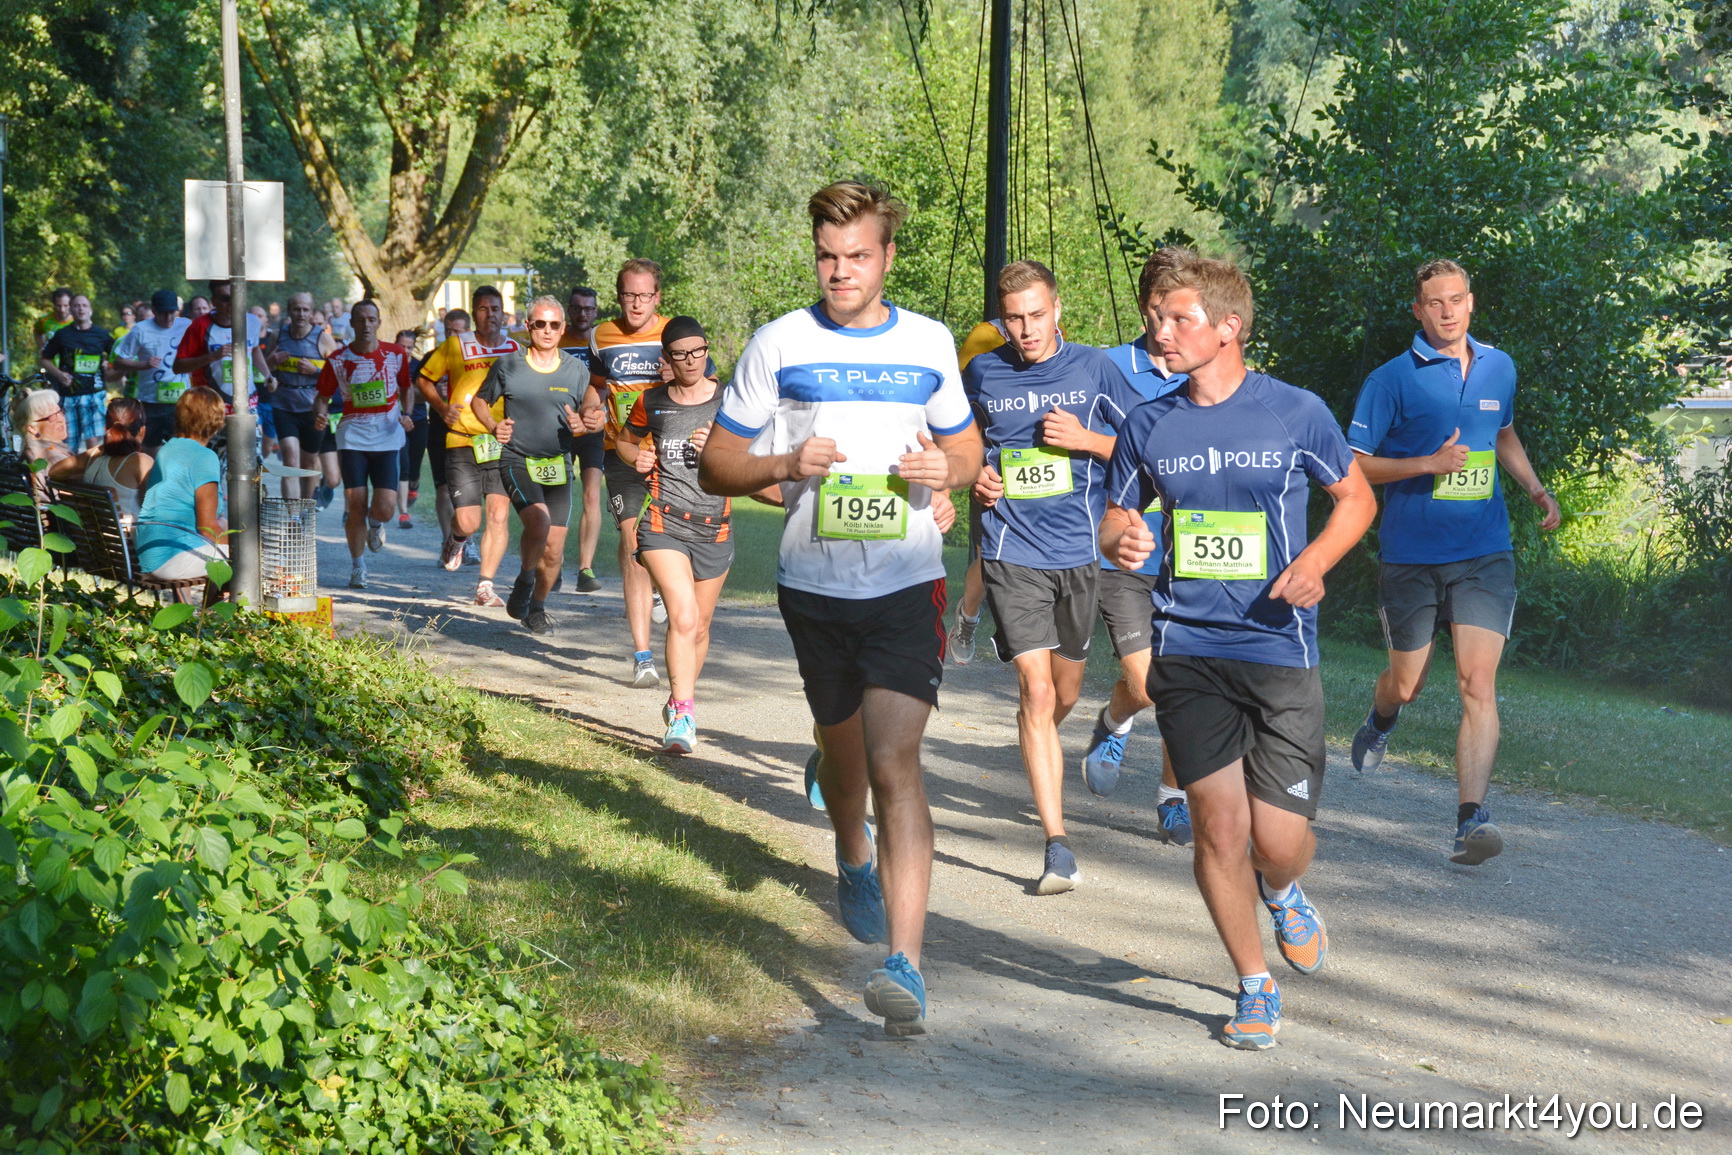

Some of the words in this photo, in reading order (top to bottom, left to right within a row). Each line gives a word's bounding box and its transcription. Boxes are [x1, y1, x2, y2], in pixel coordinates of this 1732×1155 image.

[464, 361, 491, 372] MAX
[812, 368, 840, 384] TR
[846, 370, 922, 386] PLAST
[163, 389, 181, 398] 471
[355, 389, 382, 401] 1855
[987, 396, 1026, 413] EURO
[1041, 390, 1087, 408] POLES
[478, 441, 503, 454] 1229
[667, 449, 697, 460] DESI
[1157, 454, 1205, 476] EURO
[1224, 451, 1282, 469] POLES
[535, 465, 557, 478] 283
[1016, 464, 1056, 485] 485
[1447, 468, 1489, 487] 1513
[831, 496, 897, 521] 1954
[1193, 535, 1244, 560] 530
[1186, 559, 1222, 567] Großmann
